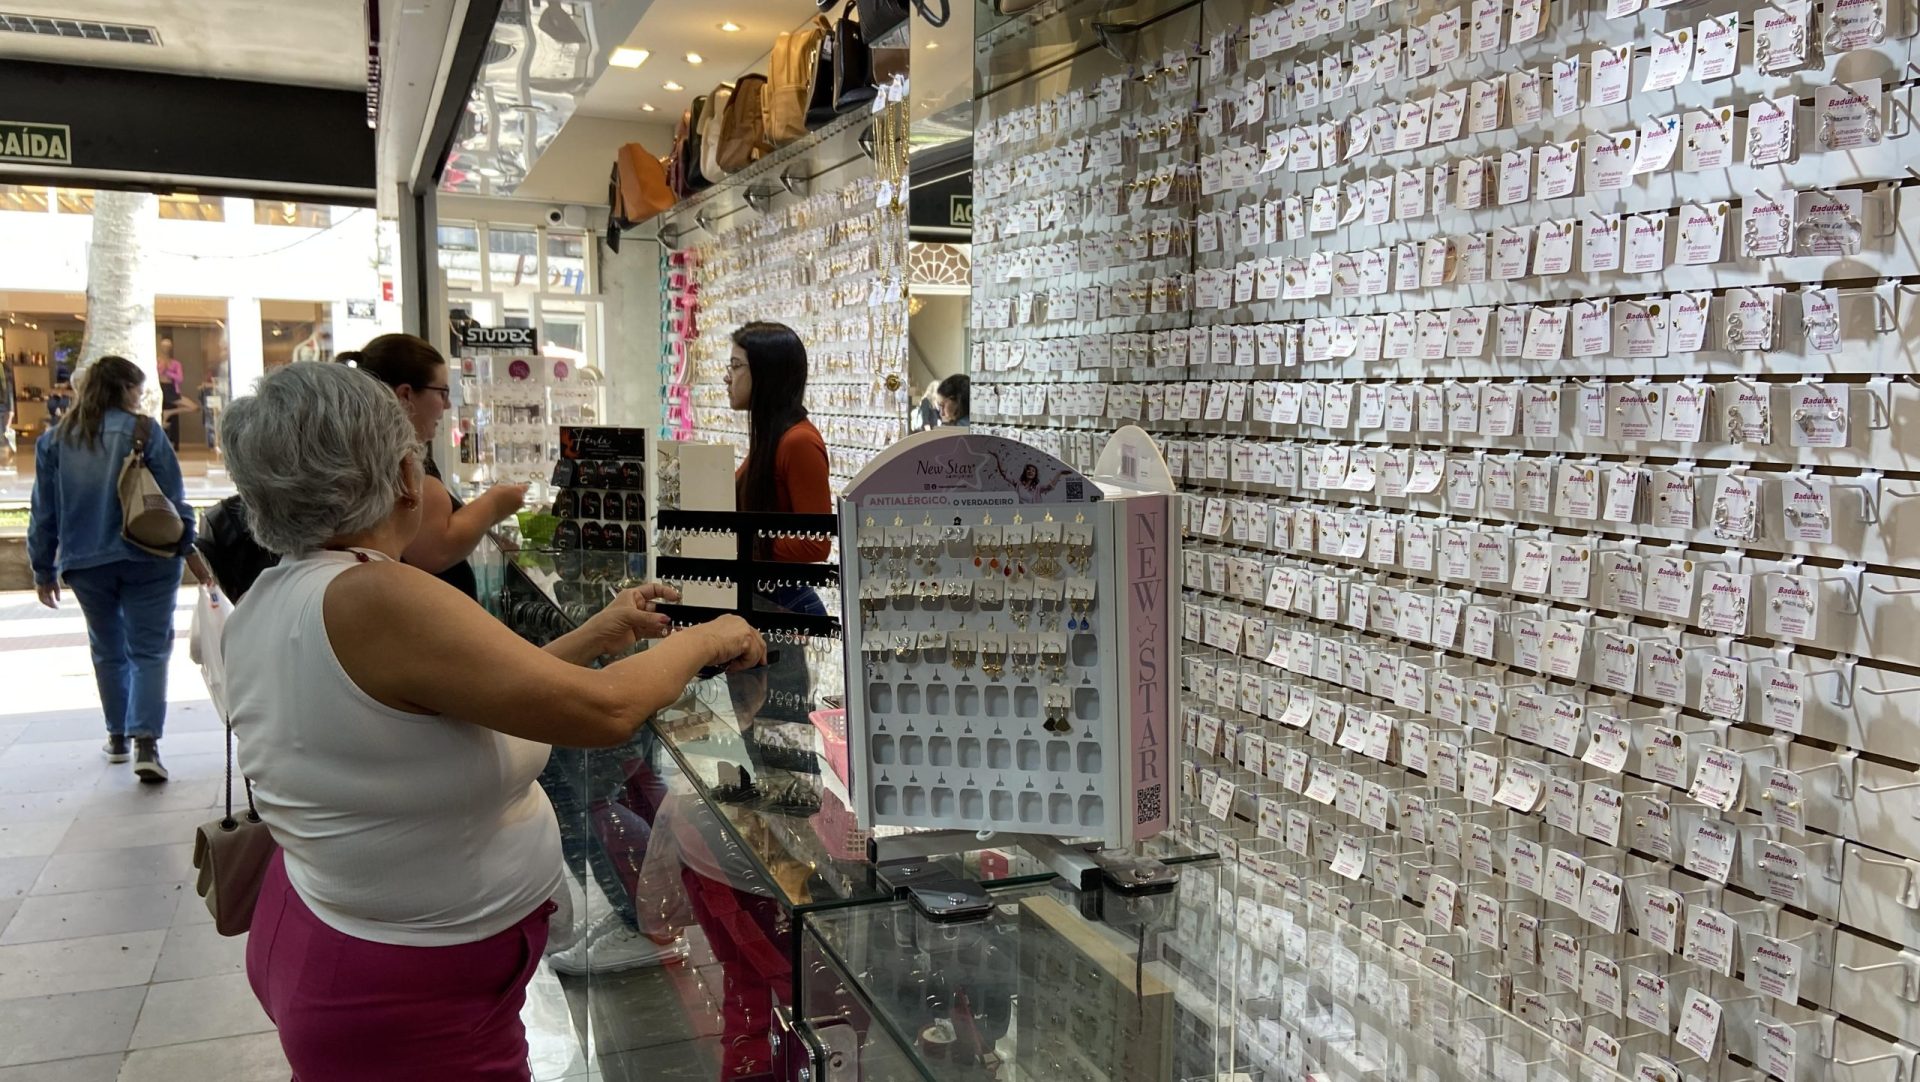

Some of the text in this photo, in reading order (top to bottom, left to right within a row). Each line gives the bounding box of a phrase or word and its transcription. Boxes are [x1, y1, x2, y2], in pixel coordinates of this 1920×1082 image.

[1828, 95, 1869, 106] Badulak's
[0, 127, 65, 158] AÍDA
[1753, 205, 1784, 214] Badulak's
[1810, 204, 1850, 212] Badulak's
[466, 328, 532, 342] STUDEX
[917, 459, 975, 475] New Star
[961, 498, 1014, 506] VERDADEIRO
[1778, 587, 1810, 597] Badulak's
[1132, 512, 1162, 782] NEW STAR
[1712, 669, 1739, 679] Badulak's
[1772, 679, 1798, 690] Badulak's
[1706, 757, 1732, 770] Badulak's
[1771, 779, 1797, 792] Badulak's
[1698, 828, 1727, 842] Badulak's
[1765, 852, 1797, 866] Badulak's
[1697, 918, 1725, 934] Badulak's
[1758, 947, 1791, 962] Badulak's
